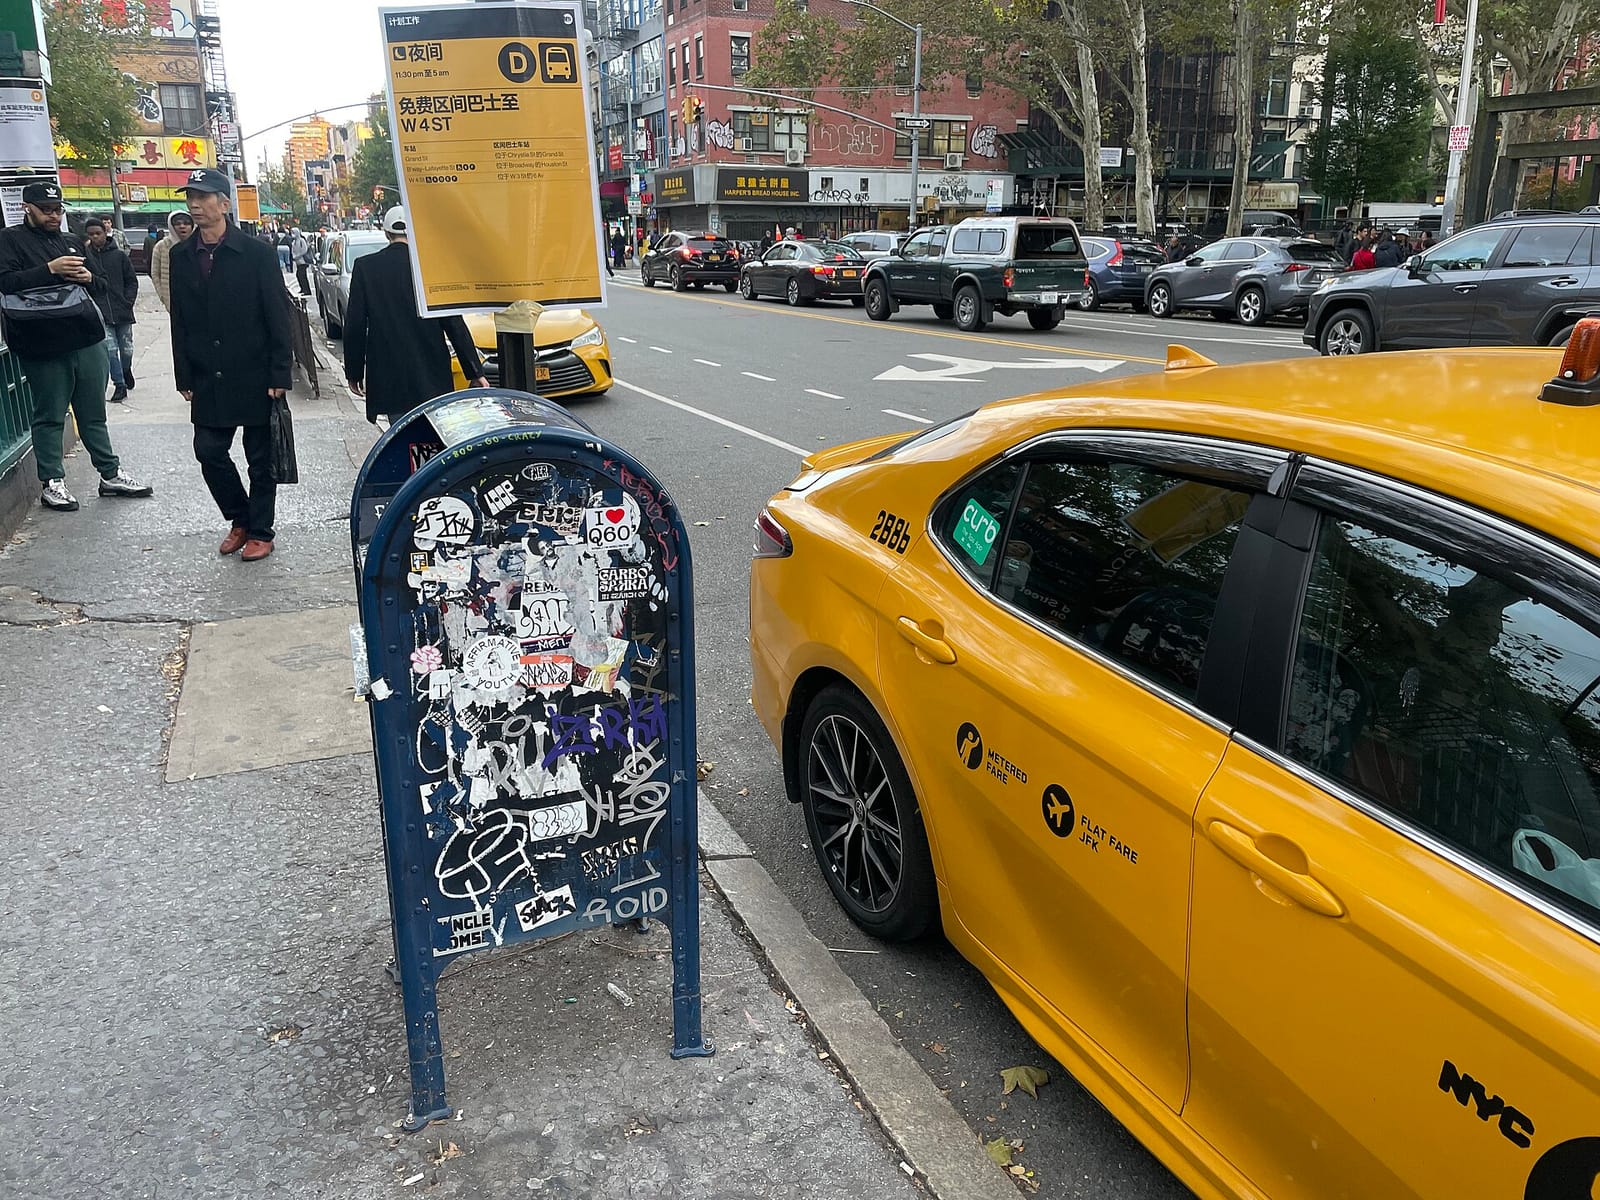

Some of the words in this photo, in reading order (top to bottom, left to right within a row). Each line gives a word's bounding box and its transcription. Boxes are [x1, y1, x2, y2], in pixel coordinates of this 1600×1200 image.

[388, 15, 421, 27] 计划工作
[407, 42, 443, 62] 夜间
[508, 51, 528, 74] D
[399, 93, 520, 115] 免费区间巴士至
[594, 510, 604, 526] I
[962, 504, 998, 544] curb
[588, 525, 631, 547] Q60
[466, 638, 521, 668] AFFIRMATIVE
[475, 672, 518, 690] YOUTH
[986, 762, 1009, 785] FARE
[987, 748, 1028, 784] METERED
[1079, 832, 1099, 853] JFK
[1080, 815, 1107, 841] FLAT
[1109, 835, 1138, 864] FARE
[453, 912, 491, 932] NGLE
[1438, 1059, 1535, 1149] NYC
